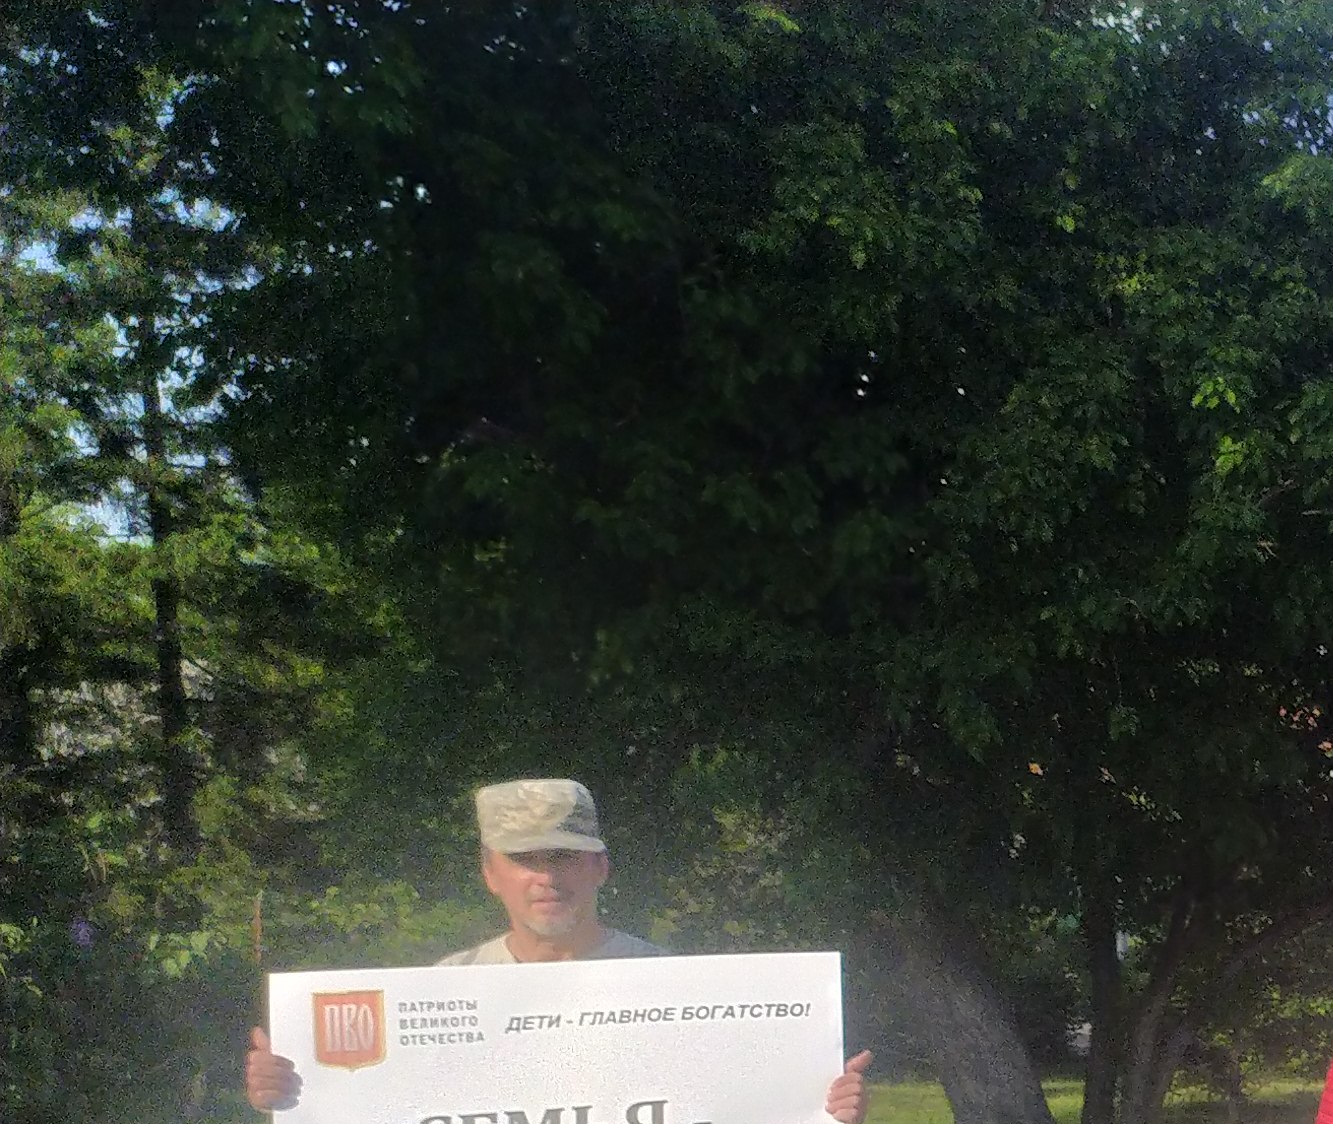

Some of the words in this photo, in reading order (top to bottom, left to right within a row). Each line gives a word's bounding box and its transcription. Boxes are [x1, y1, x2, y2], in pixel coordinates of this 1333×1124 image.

[398, 1000, 478, 1013] ПАТРИОТЫ
[399, 1015, 479, 1030] ВЕЛИКОГО
[505, 1016, 561, 1034] ДЕТИ
[578, 1007, 676, 1028] ГЛАВНОЕ
[680, 1002, 811, 1022] БОГАТСТВО!
[400, 1031, 485, 1046] ОТЕЧЕСТВА
